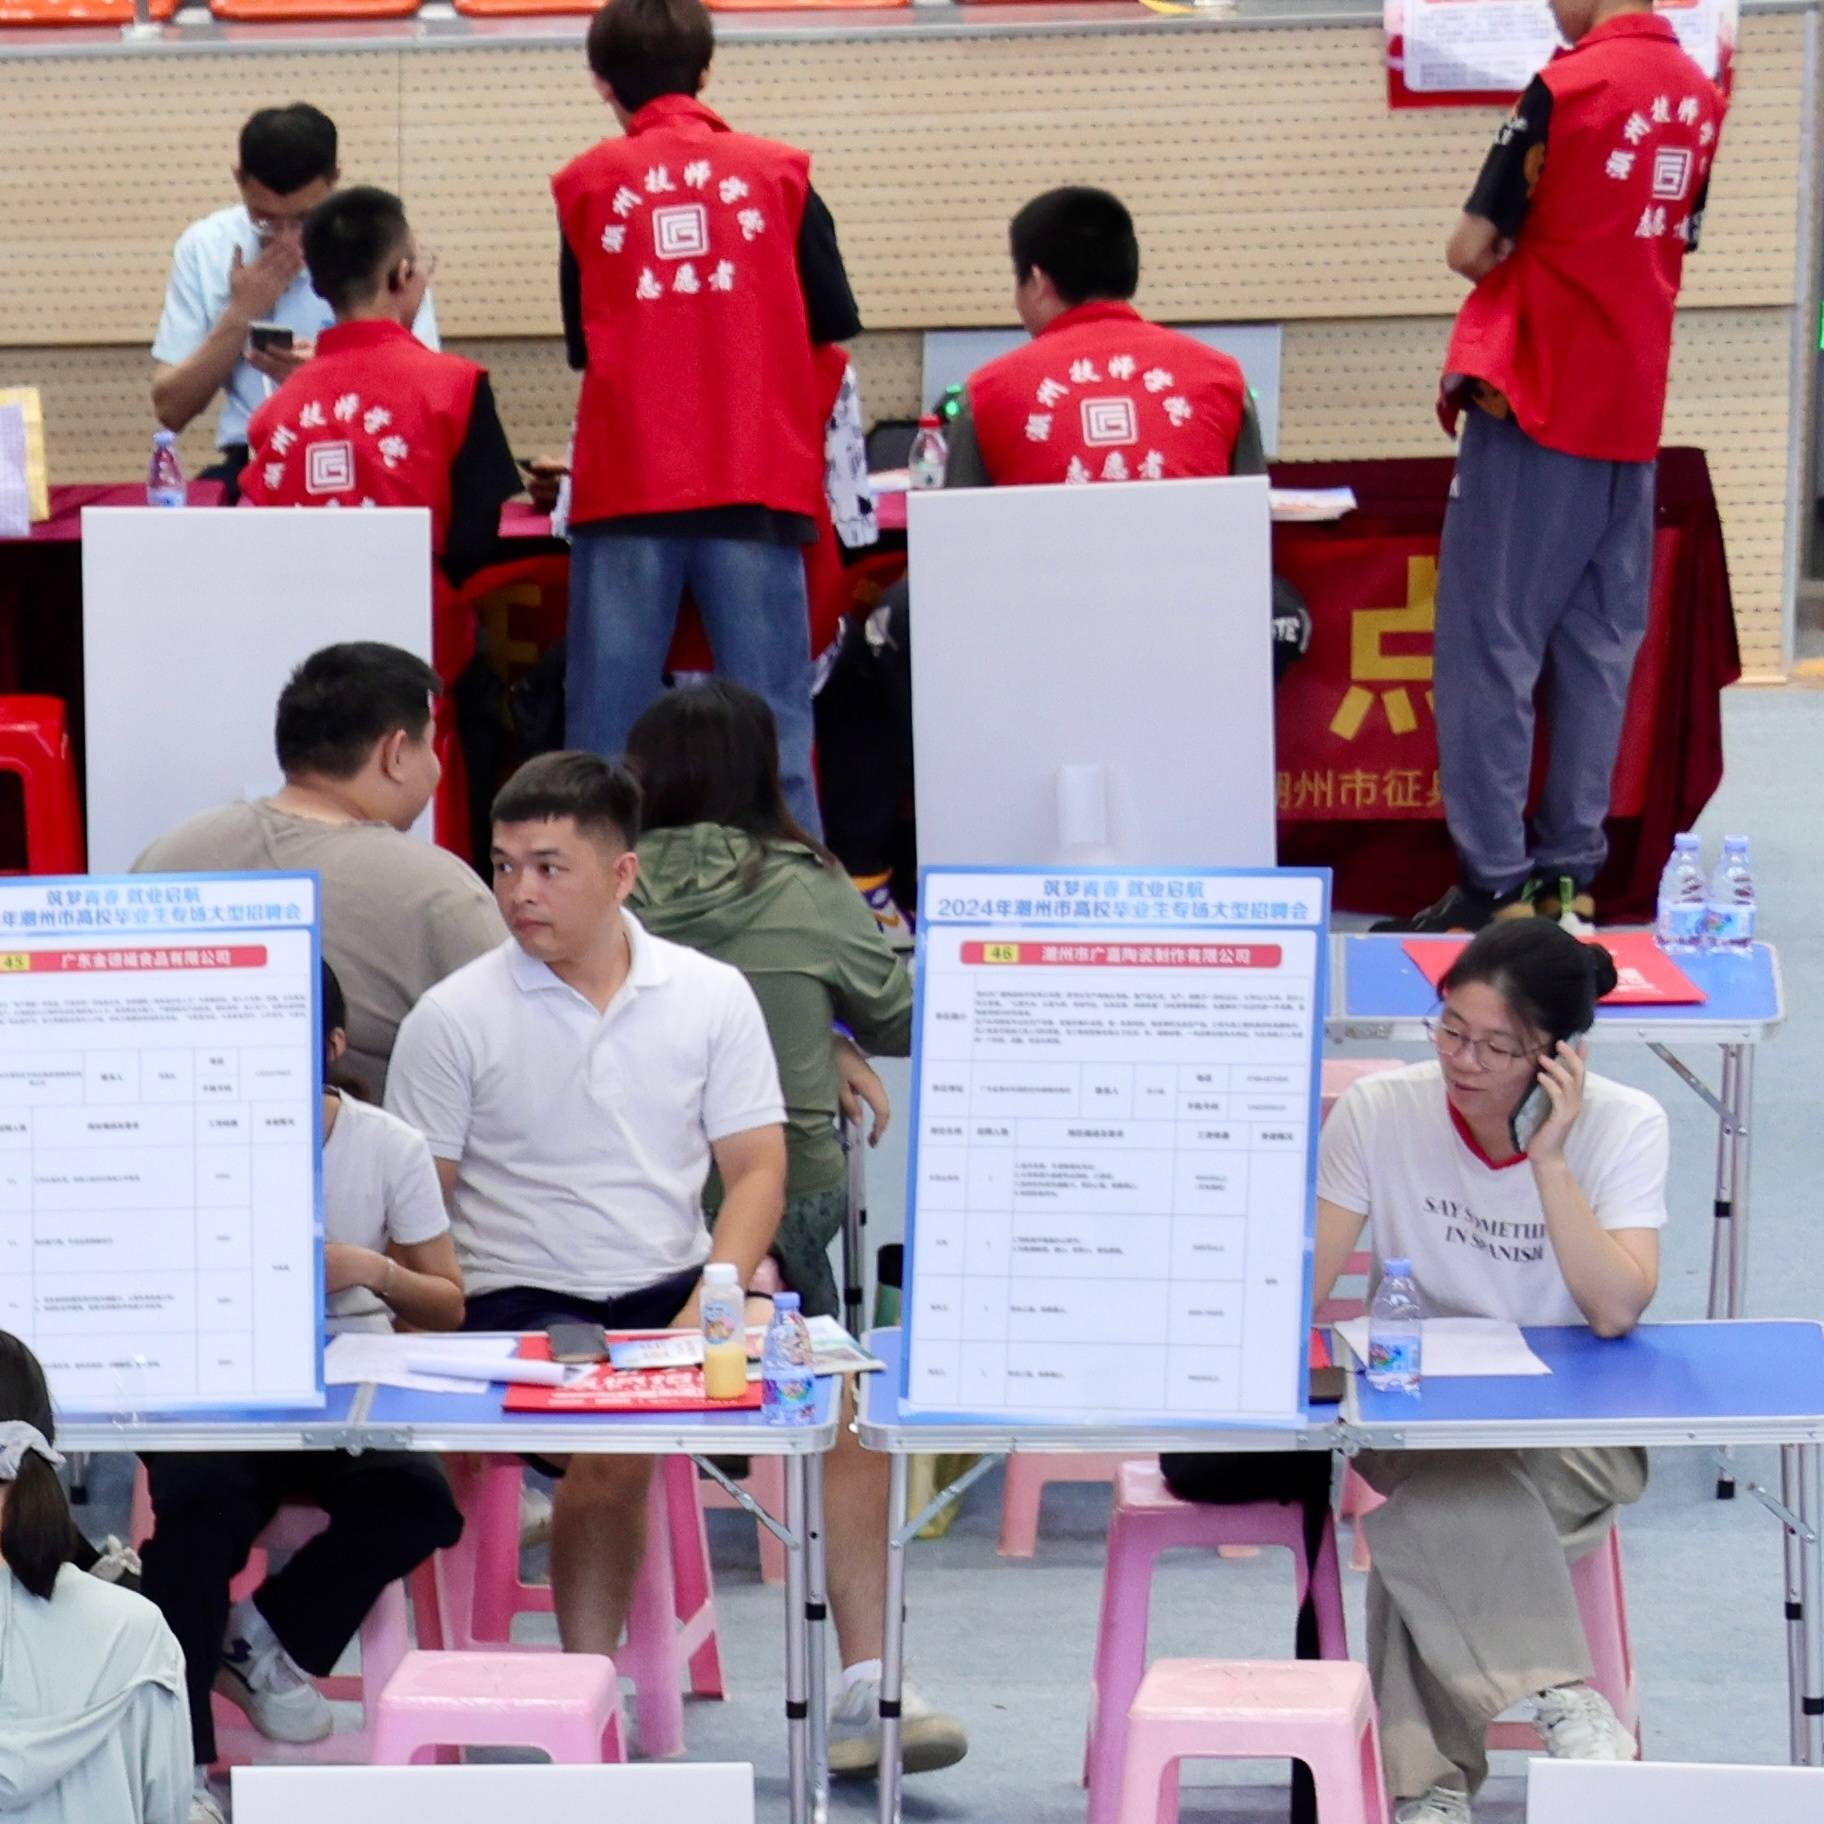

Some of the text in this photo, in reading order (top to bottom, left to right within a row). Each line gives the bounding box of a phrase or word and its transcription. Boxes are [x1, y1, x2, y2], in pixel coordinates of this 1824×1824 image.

[636, 259, 736, 300] 志愿者
[990, 946, 1013, 961] 46
